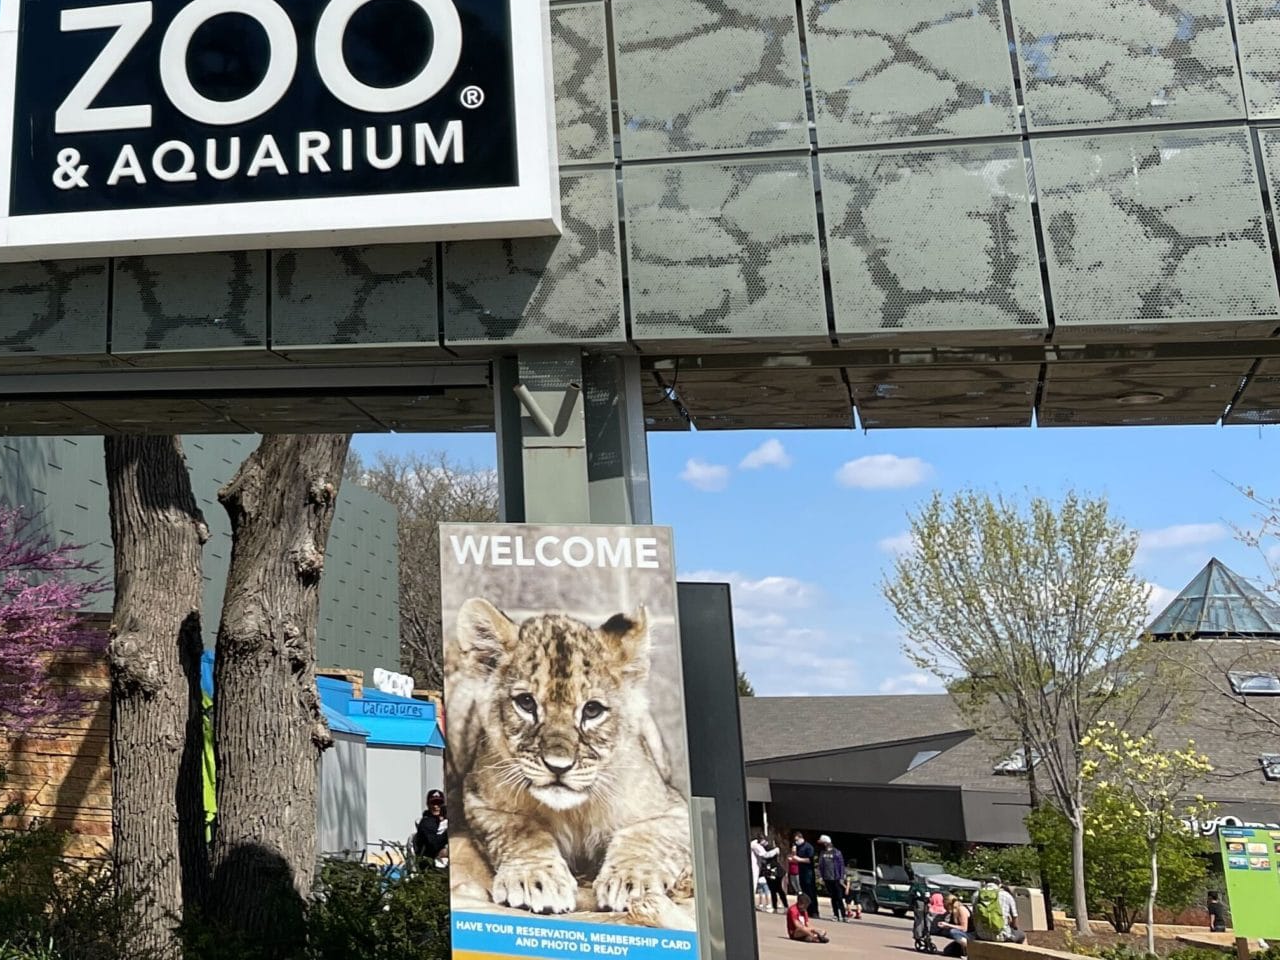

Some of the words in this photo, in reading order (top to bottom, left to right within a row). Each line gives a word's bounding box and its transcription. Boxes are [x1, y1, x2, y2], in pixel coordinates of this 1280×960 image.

[52, 147, 90, 190] &
[106, 119, 465, 186] AQUARIUM
[450, 535, 659, 568] WELCOME
[362, 701, 423, 717] Caricatures
[456, 921, 483, 931] HAVE
[485, 923, 513, 935] YOUR
[516, 926, 587, 941] RESERVATION,
[590, 933, 658, 947] MEMBERSHIP
[661, 939, 691, 950] CARD
[516, 938, 538, 947] AND
[541, 940, 577, 951] PHOTO
[580, 944, 591, 952] ID
[594, 945, 628, 956] READY
